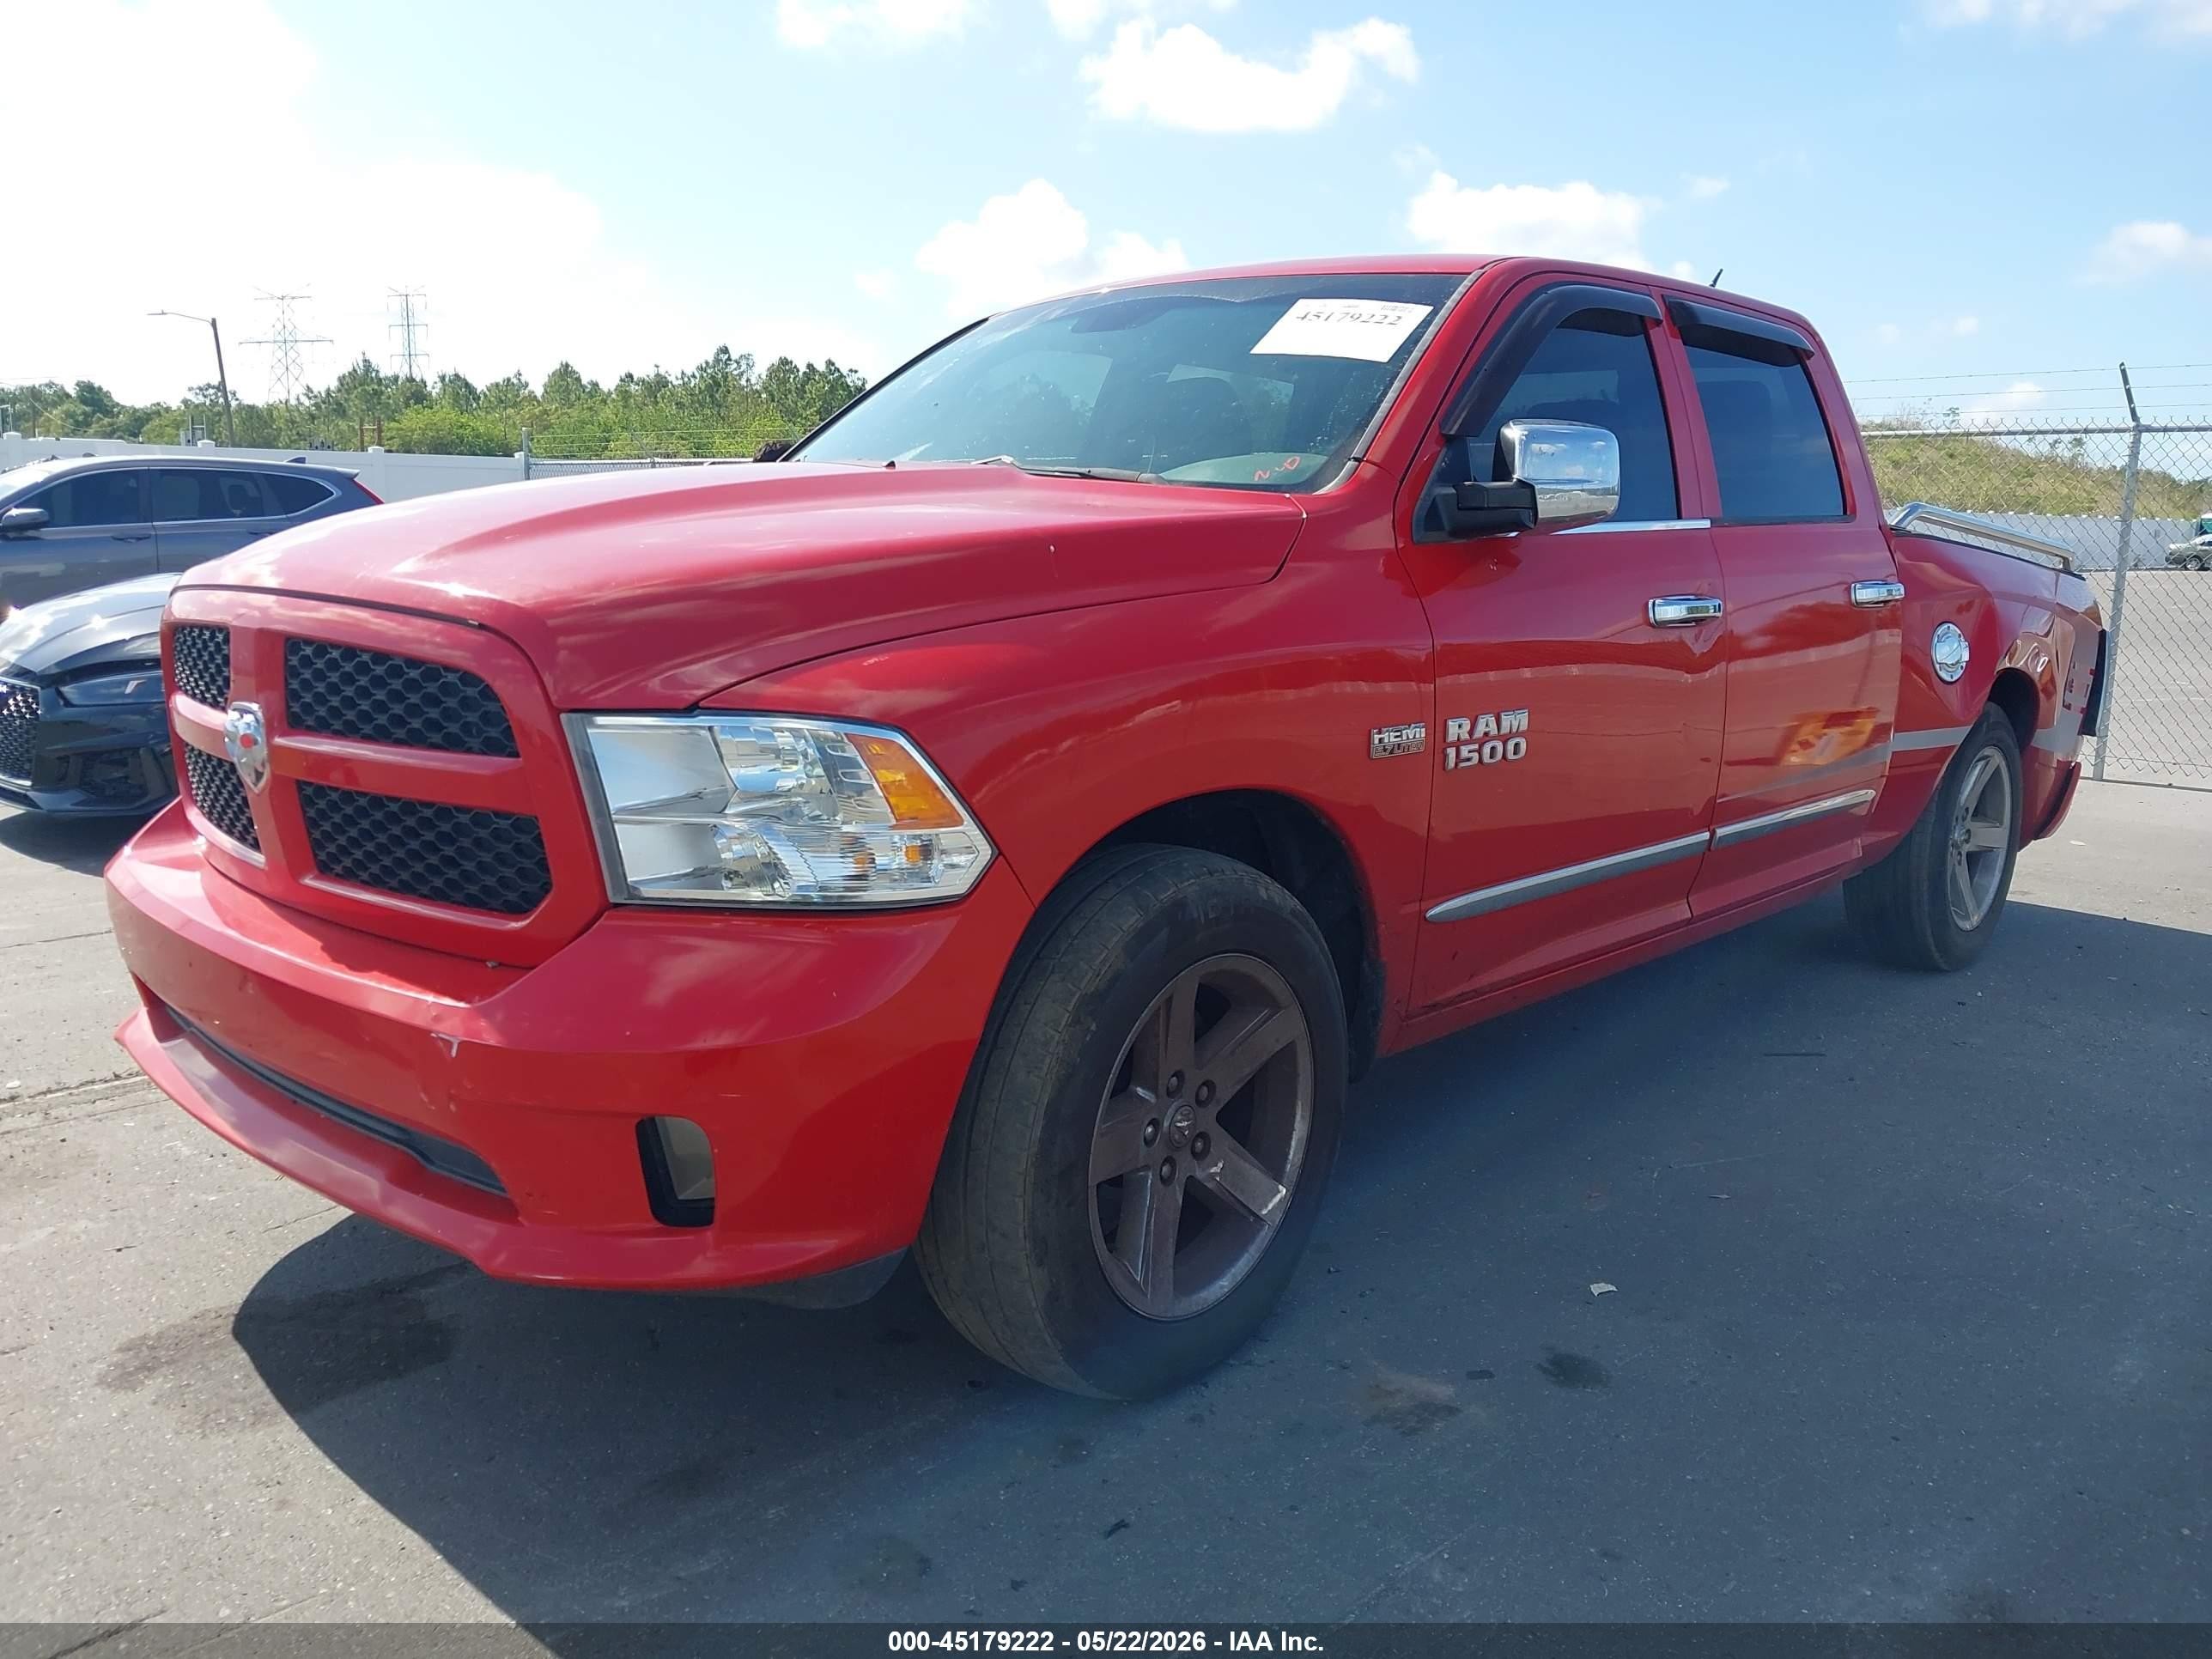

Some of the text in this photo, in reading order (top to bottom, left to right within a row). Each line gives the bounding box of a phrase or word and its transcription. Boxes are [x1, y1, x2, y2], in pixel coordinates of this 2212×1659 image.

[1296, 310, 1403, 325] 45179222
[1373, 722, 1426, 744] HEMI
[1445, 708, 1529, 743] RAM
[1374, 741, 1424, 757] 5.7 LITER
[1443, 736, 1528, 771] 1500
